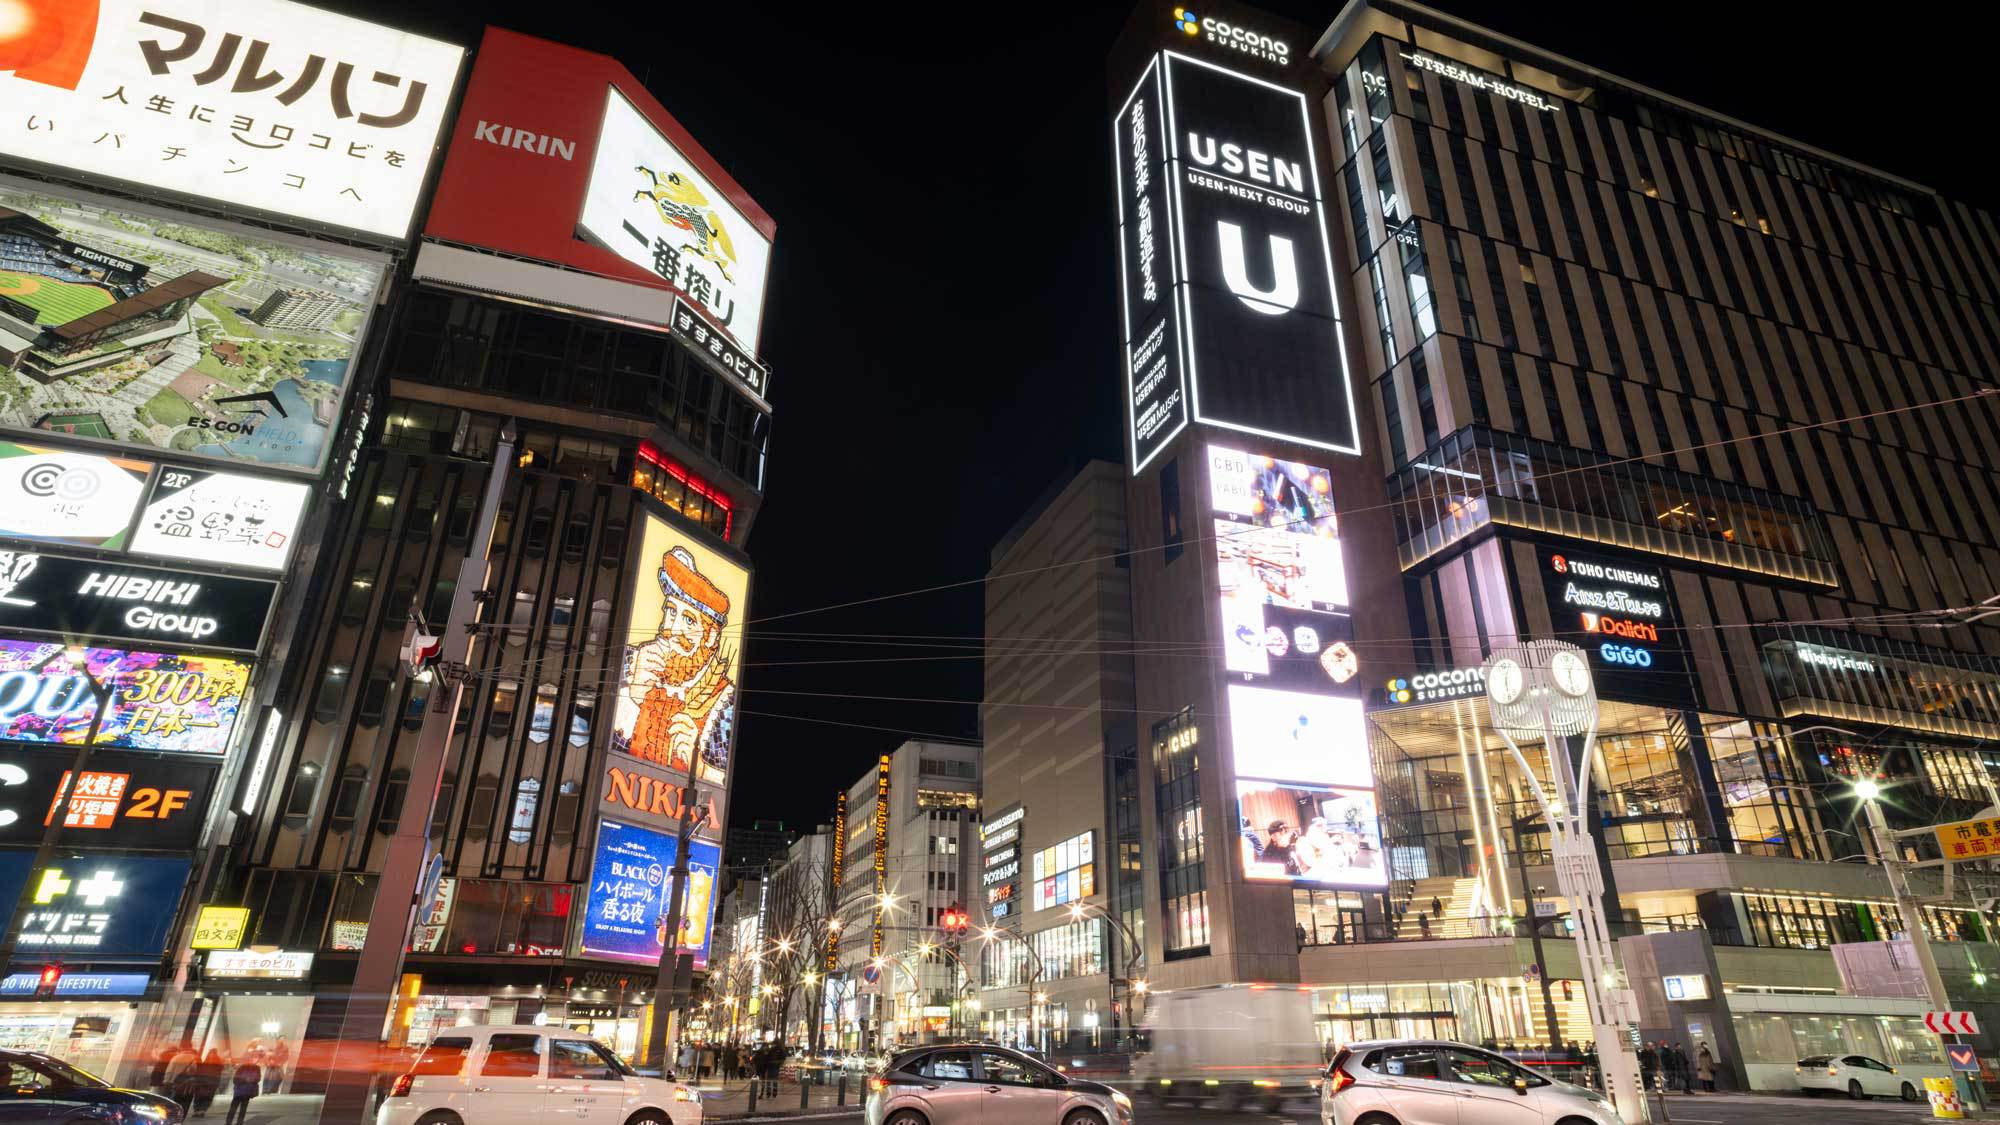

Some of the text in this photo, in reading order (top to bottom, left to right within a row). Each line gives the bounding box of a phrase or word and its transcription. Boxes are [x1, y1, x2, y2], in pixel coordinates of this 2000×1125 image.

[138, 11, 427, 129] マルハン
[102, 85, 406, 168] 人生にヨロコビを
[474, 119, 577, 161] KIRIN
[1188, 132, 1304, 192] USEN
[1188, 173, 1310, 216] USEN-NEXT GROUP
[73, 246, 134, 272] FIGHTERS
[622, 218, 734, 327] 一番搾り
[679, 311, 760, 388] すすきのビル
[1133, 344, 1152, 374] USEN
[1135, 377, 1154, 406] USEN
[1154, 363, 1168, 388] PAY
[187, 416, 255, 436] ES CON
[1137, 415, 1156, 440] USEN
[1156, 388, 1180, 419] MUSIC
[255, 426, 297, 443] FIELD
[162, 472, 193, 489] 2F
[1229, 512, 1239, 521] 1F
[1568, 560, 1660, 589] TOHO CINEMAS
[78, 572, 201, 606] HIBIKI
[1325, 603, 1336, 612] 1F
[125, 605, 218, 639] Group
[1601, 617, 1659, 642] Daiichi
[1600, 643, 1652, 668] GiGO
[123, 669, 234, 706] 300坪
[1244, 673, 1255, 682] 1F
[1417, 683, 1483, 700] SUSUKIN
[124, 706, 220, 738] 日本一
[61, 773, 126, 797] 火焼き
[125, 788, 192, 819] 2F
[612, 861, 647, 882] BLACK
[595, 880, 657, 904] ハイボール
[602, 897, 647, 925] 香る夜
[197, 929, 239, 941] 四文屋
[56, 978, 112, 990] LIFESTYLE
